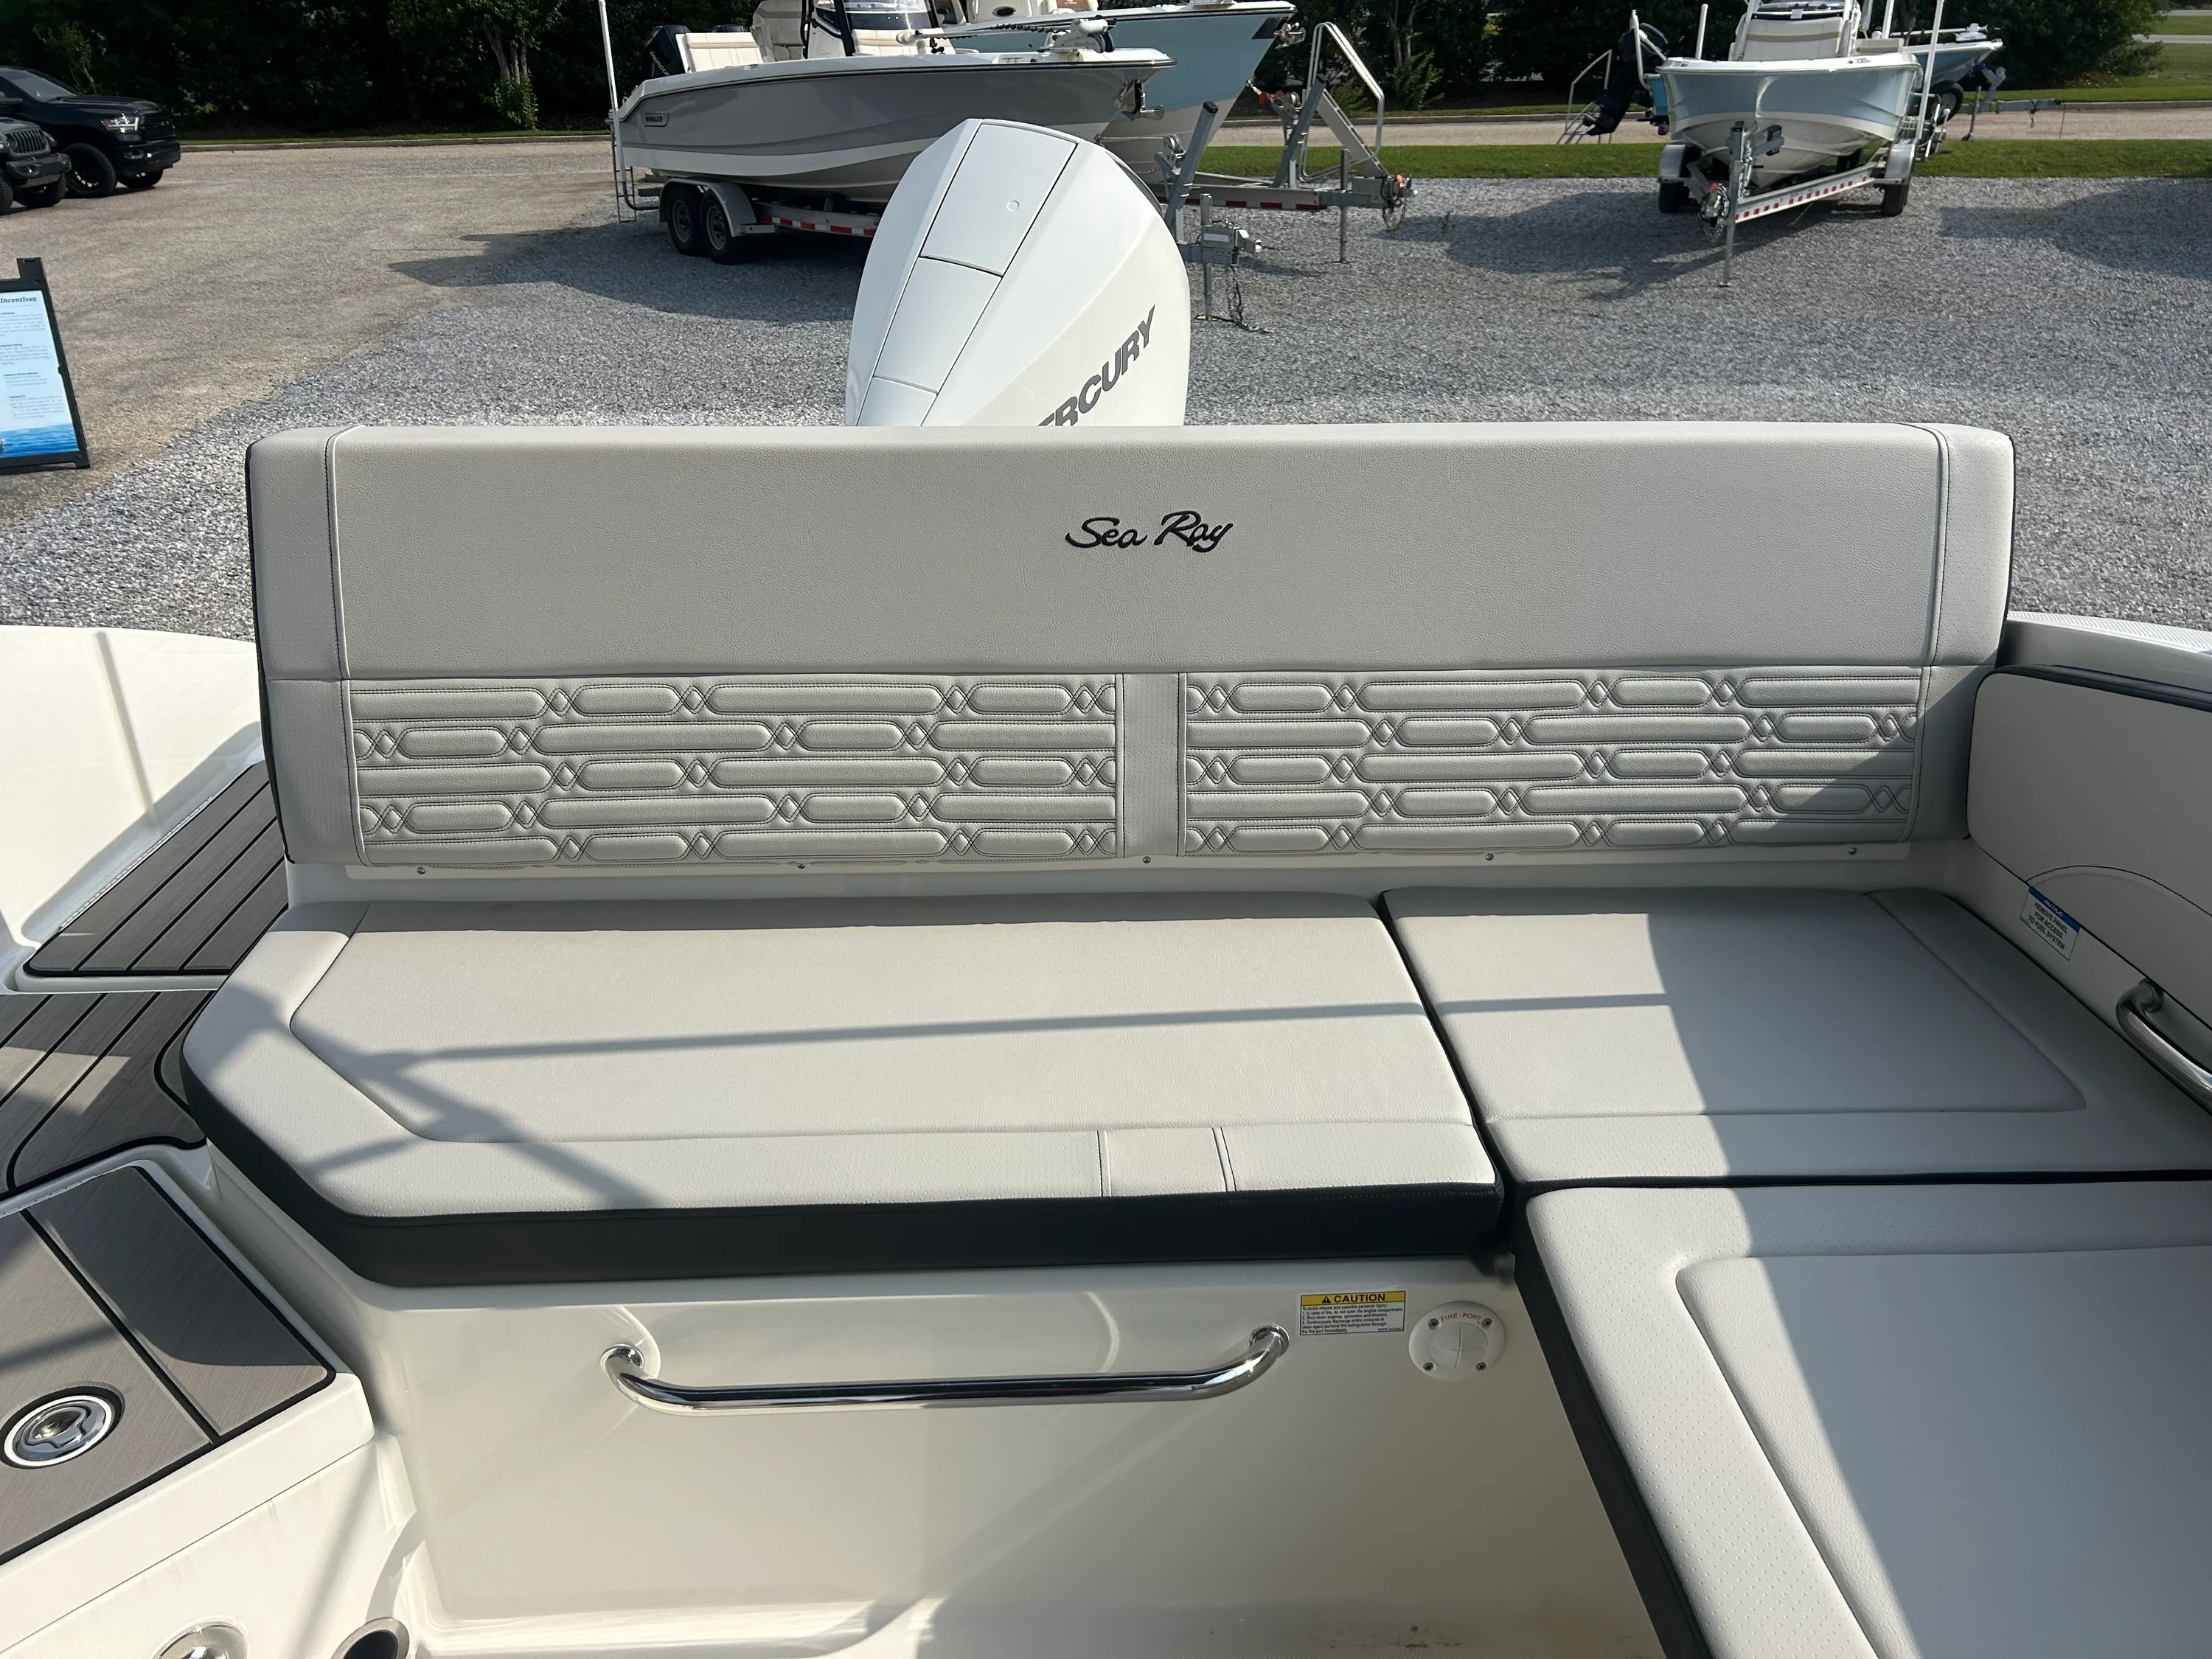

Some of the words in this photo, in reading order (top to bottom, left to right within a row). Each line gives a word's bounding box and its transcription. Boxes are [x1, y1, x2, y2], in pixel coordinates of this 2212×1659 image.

[1037, 304, 1155, 426] RCURY
[1065, 517, 1148, 549] Sea
[1154, 510, 1234, 553] Ray
[2028, 915, 2035, 924] TO
[2035, 921, 2046, 934] FUEL
[2047, 931, 2065, 950] SYSTEM
[2034, 902, 2053, 920] REMOVE
[2053, 918, 2067, 934] PANEL
[2034, 911, 2045, 922] FOR
[2044, 919, 2063, 939] ACCESS
[1334, 1293, 1385, 1303] CAUTION
